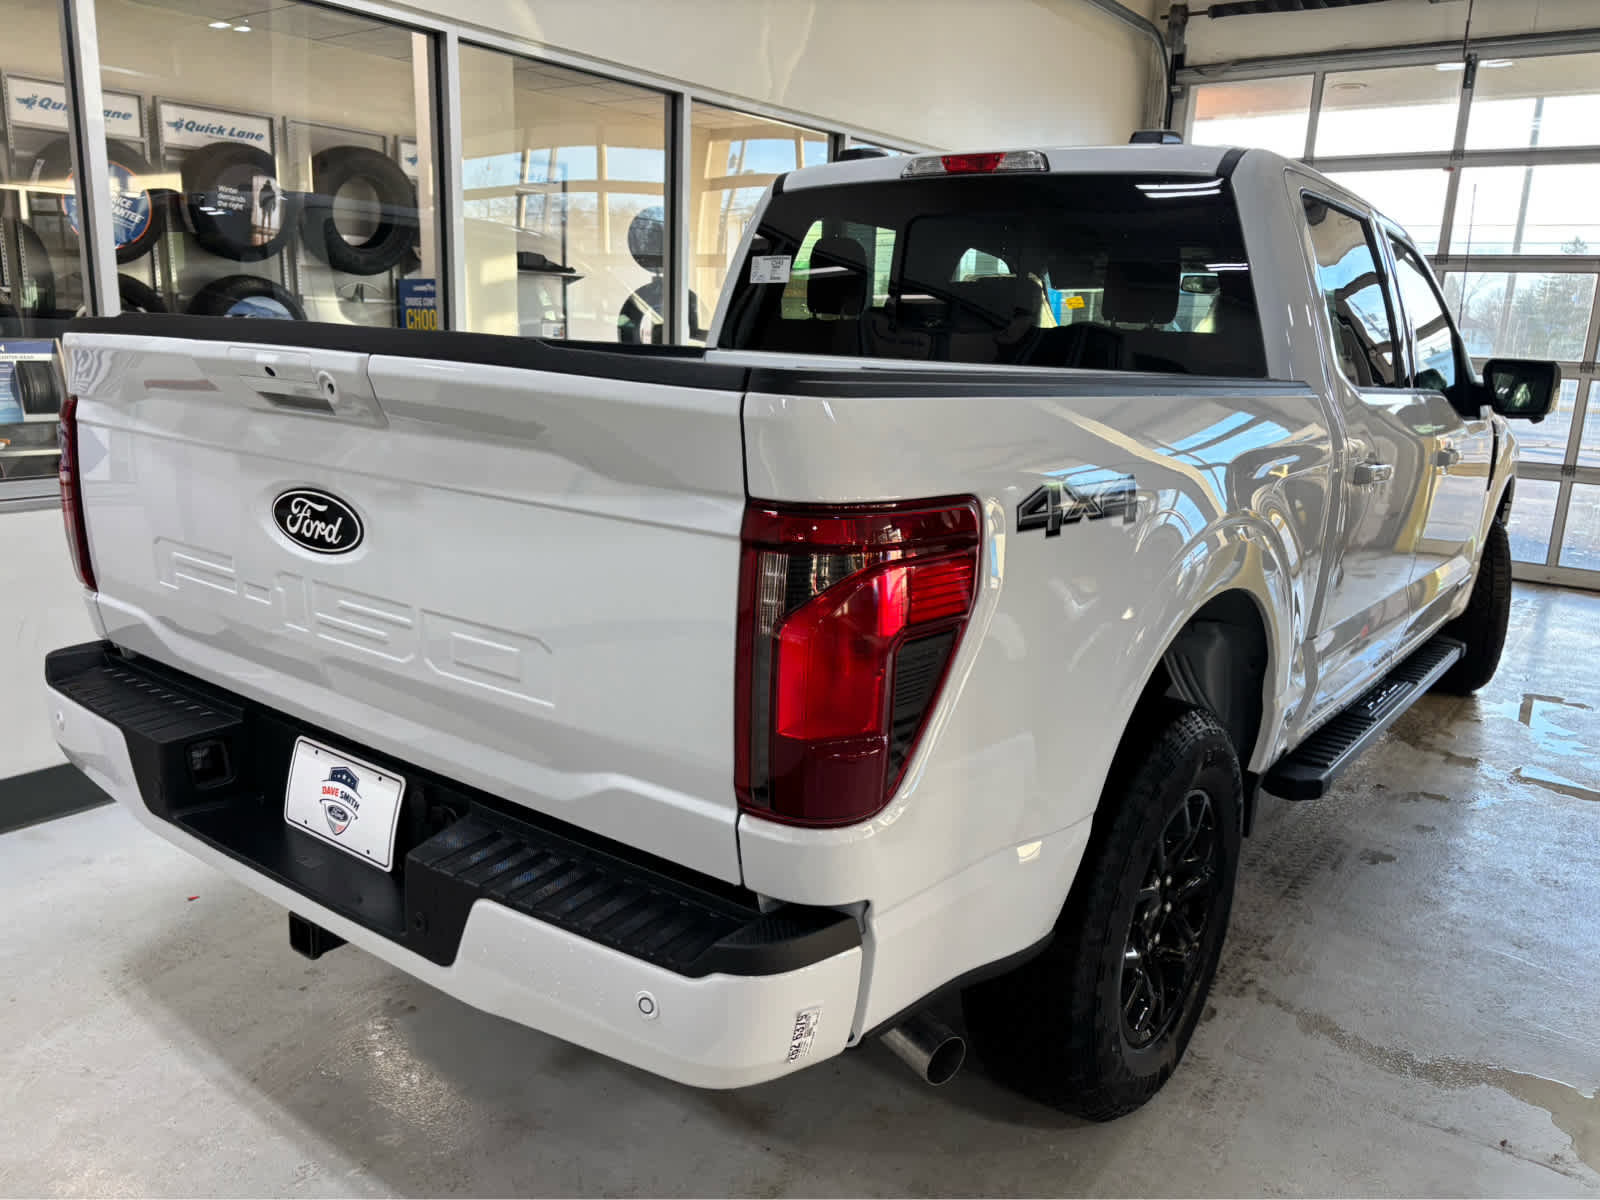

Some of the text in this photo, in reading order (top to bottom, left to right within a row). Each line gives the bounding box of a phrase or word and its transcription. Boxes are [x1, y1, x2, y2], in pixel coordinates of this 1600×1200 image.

[38, 97, 133, 120] Qui ane
[184, 120, 265, 141] Quick Lane
[286, 497, 343, 545] Ford
[154, 535, 556, 708] F-150
[321, 786, 360, 811] DAVE SMITH
